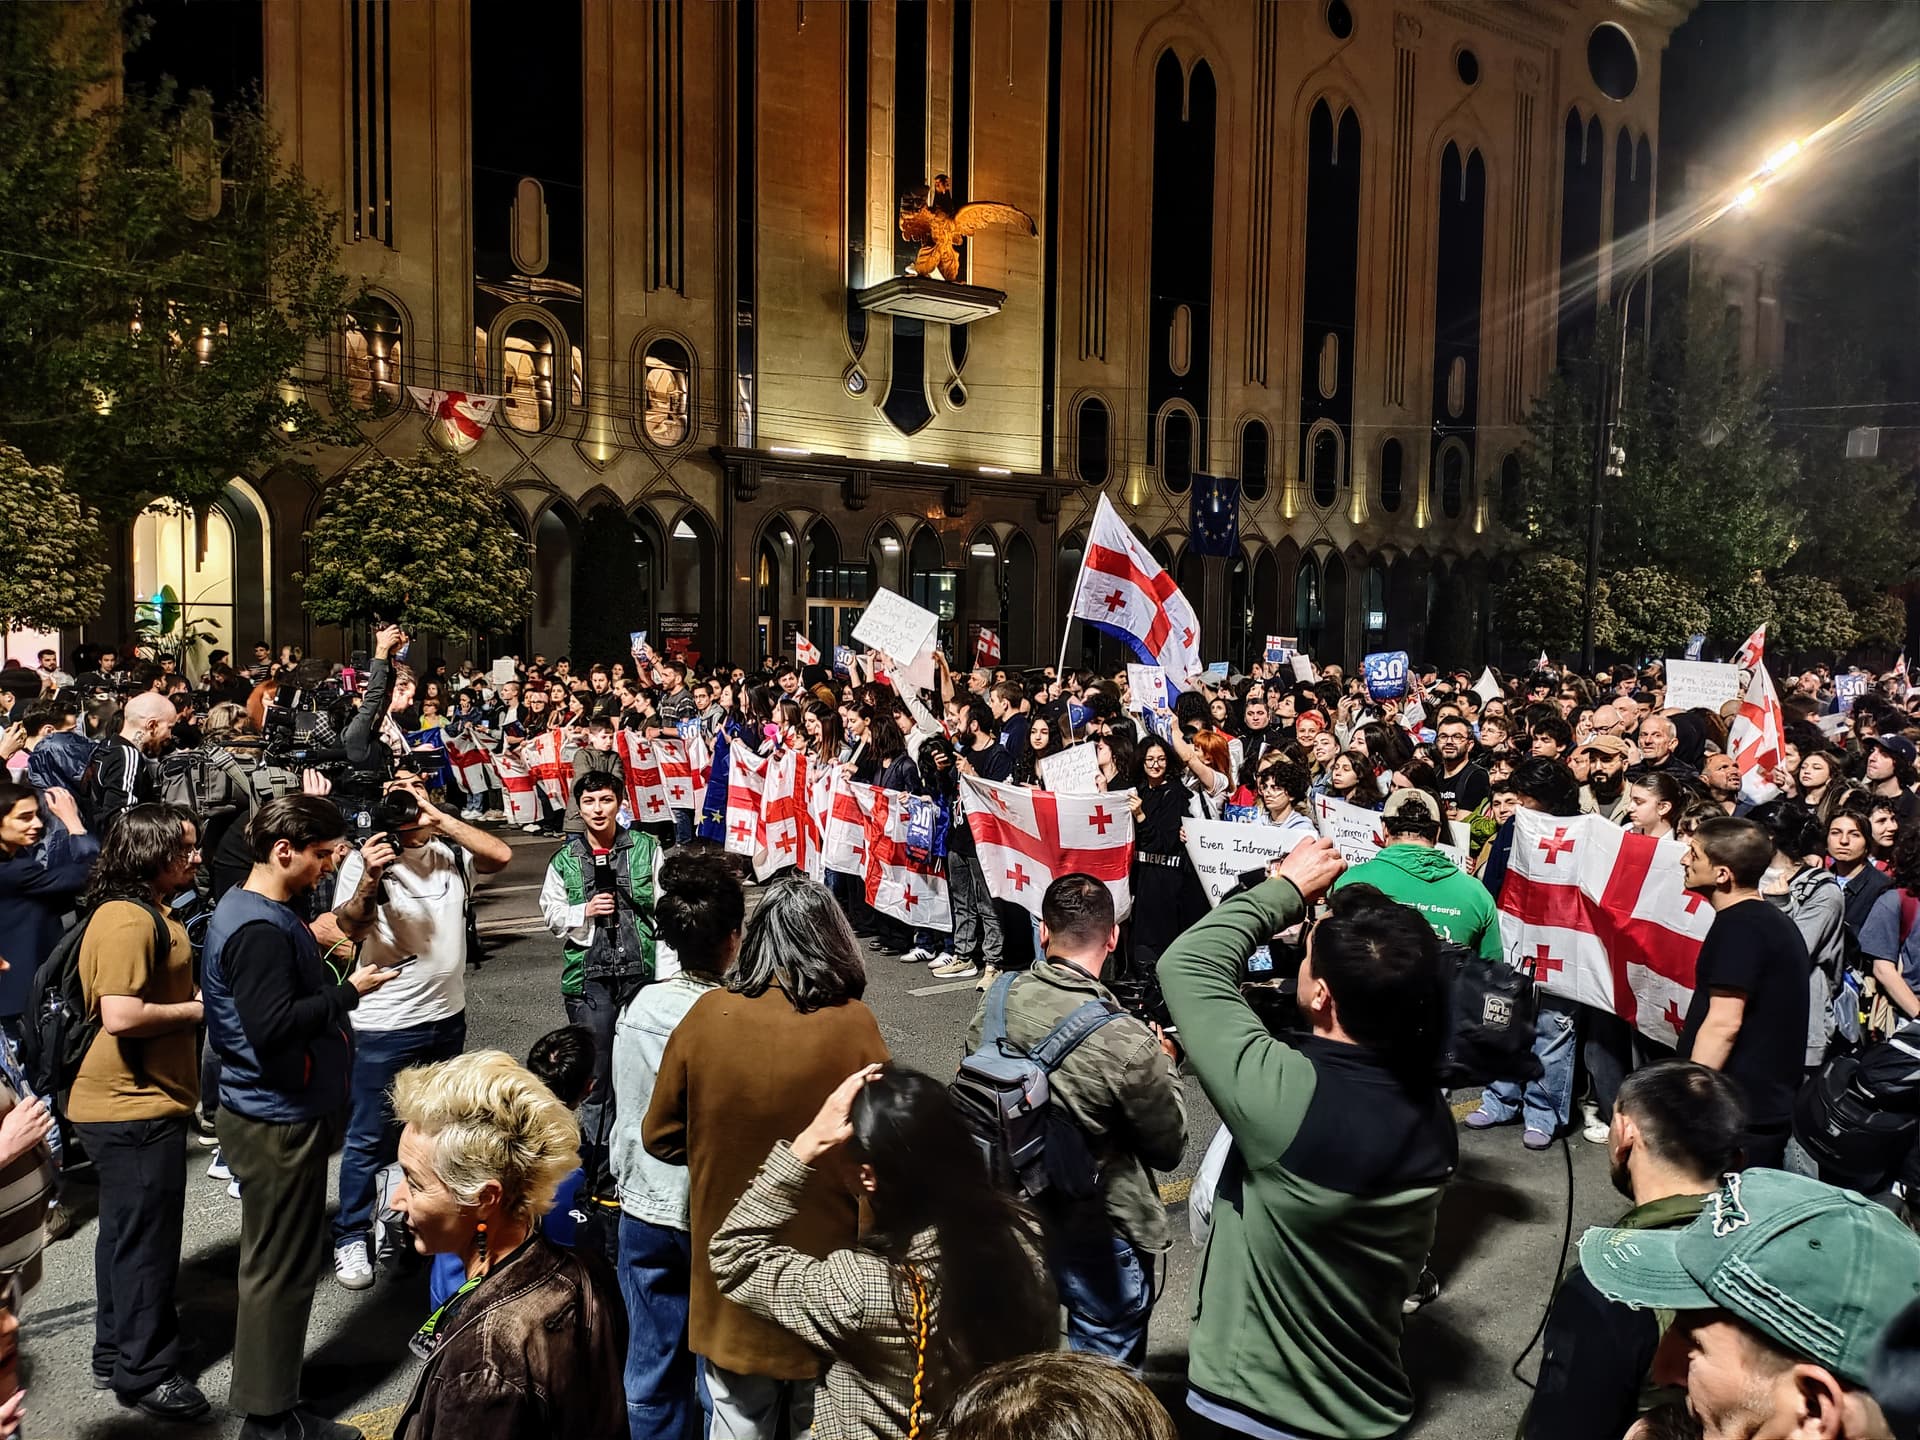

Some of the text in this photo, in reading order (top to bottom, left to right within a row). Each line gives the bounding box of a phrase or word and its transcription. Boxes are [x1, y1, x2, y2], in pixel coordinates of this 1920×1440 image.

[1200, 836, 1224, 851] Even
[1417, 903, 1430, 911] for
[1431, 904, 1461, 917] Georgia
